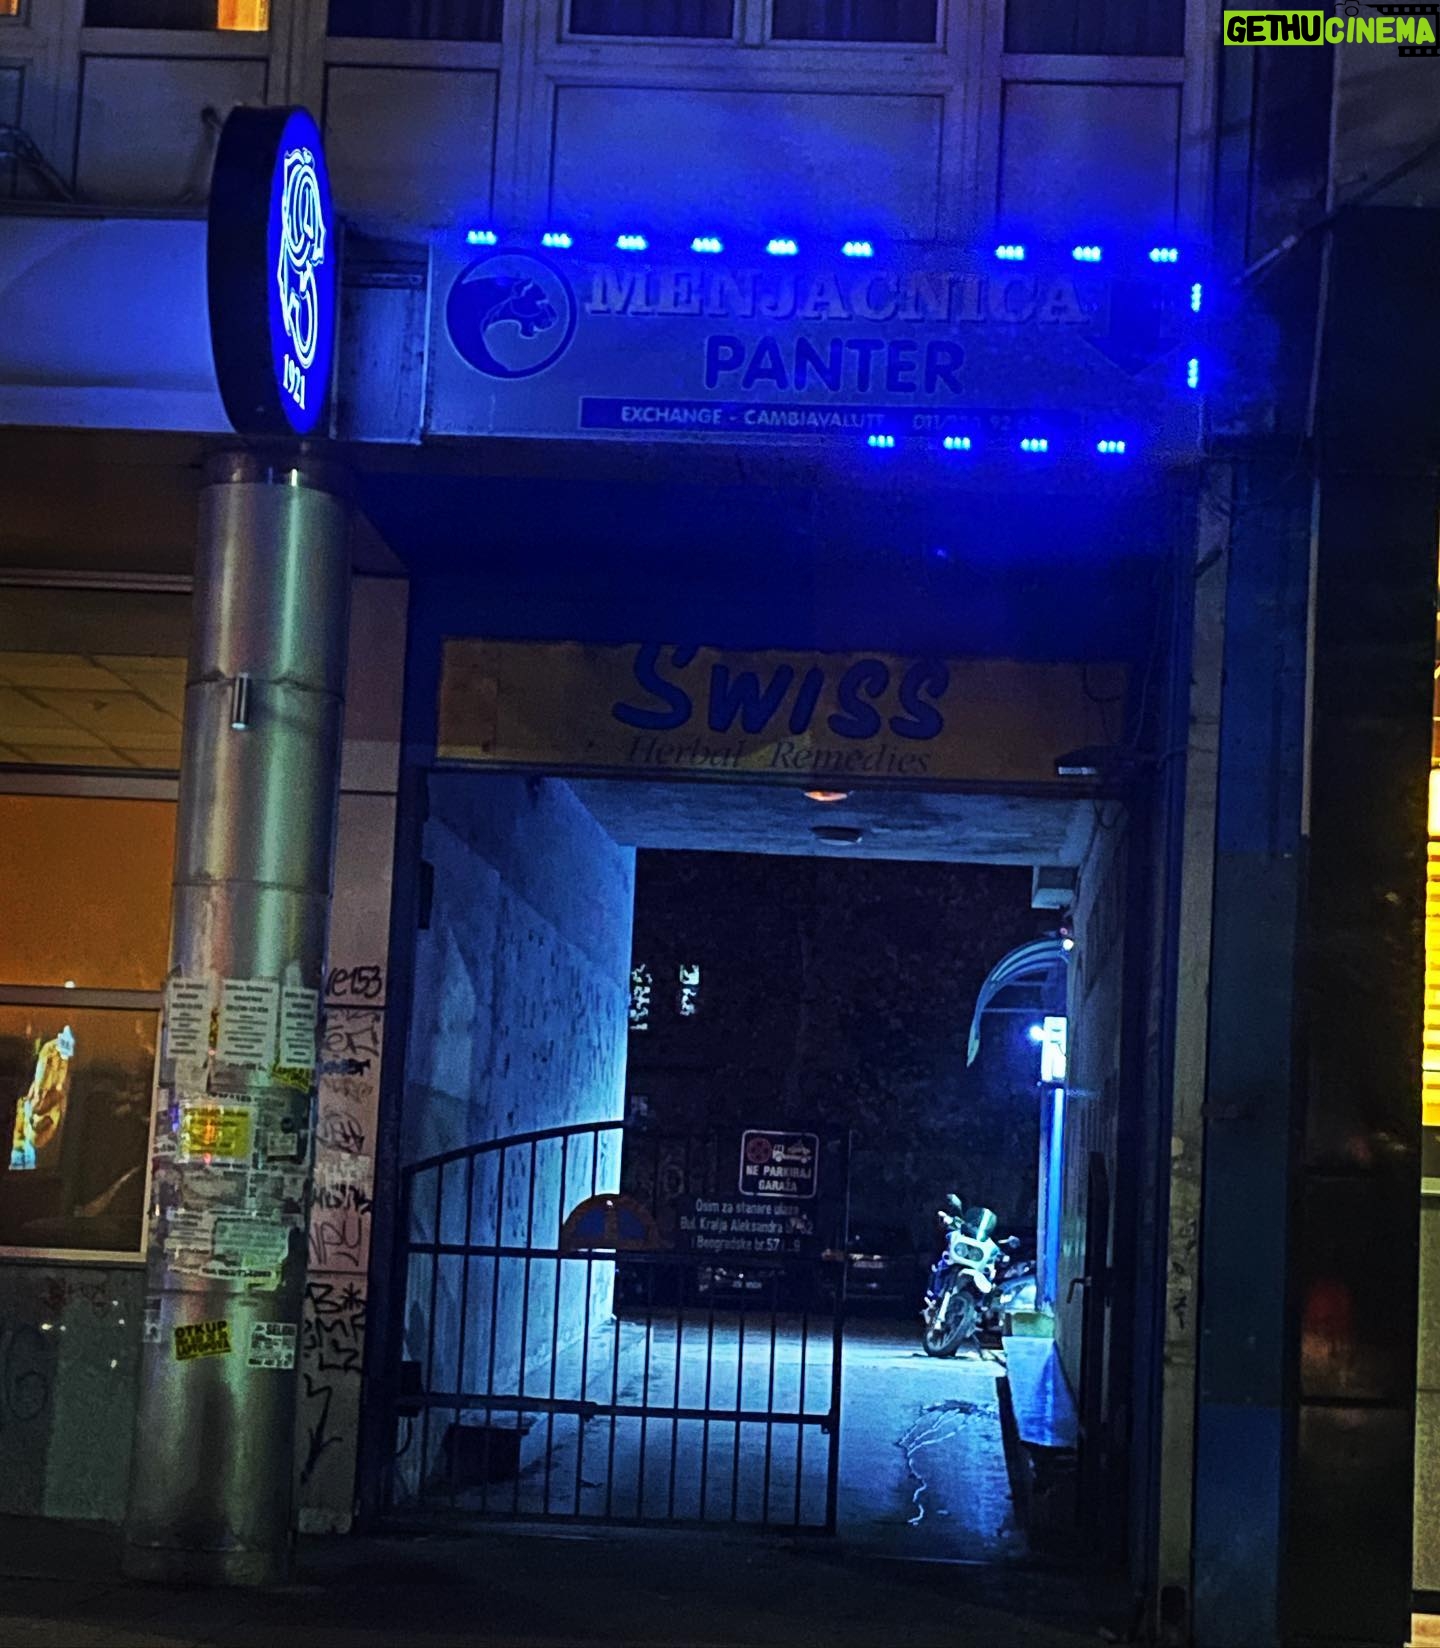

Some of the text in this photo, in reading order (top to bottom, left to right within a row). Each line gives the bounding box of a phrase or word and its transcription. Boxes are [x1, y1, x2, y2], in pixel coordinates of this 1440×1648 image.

[704, 334, 966, 394] PANTER
[283, 353, 306, 410] 1921
[620, 406, 722, 425] EXCHANGE
[627, 735, 932, 773] Herbal Remedies
[745, 1165, 812, 1179] NE PARKIRAJ
[730, 1218, 783, 1234] Aleksandra
[175, 1320, 227, 1338] OTKUP
